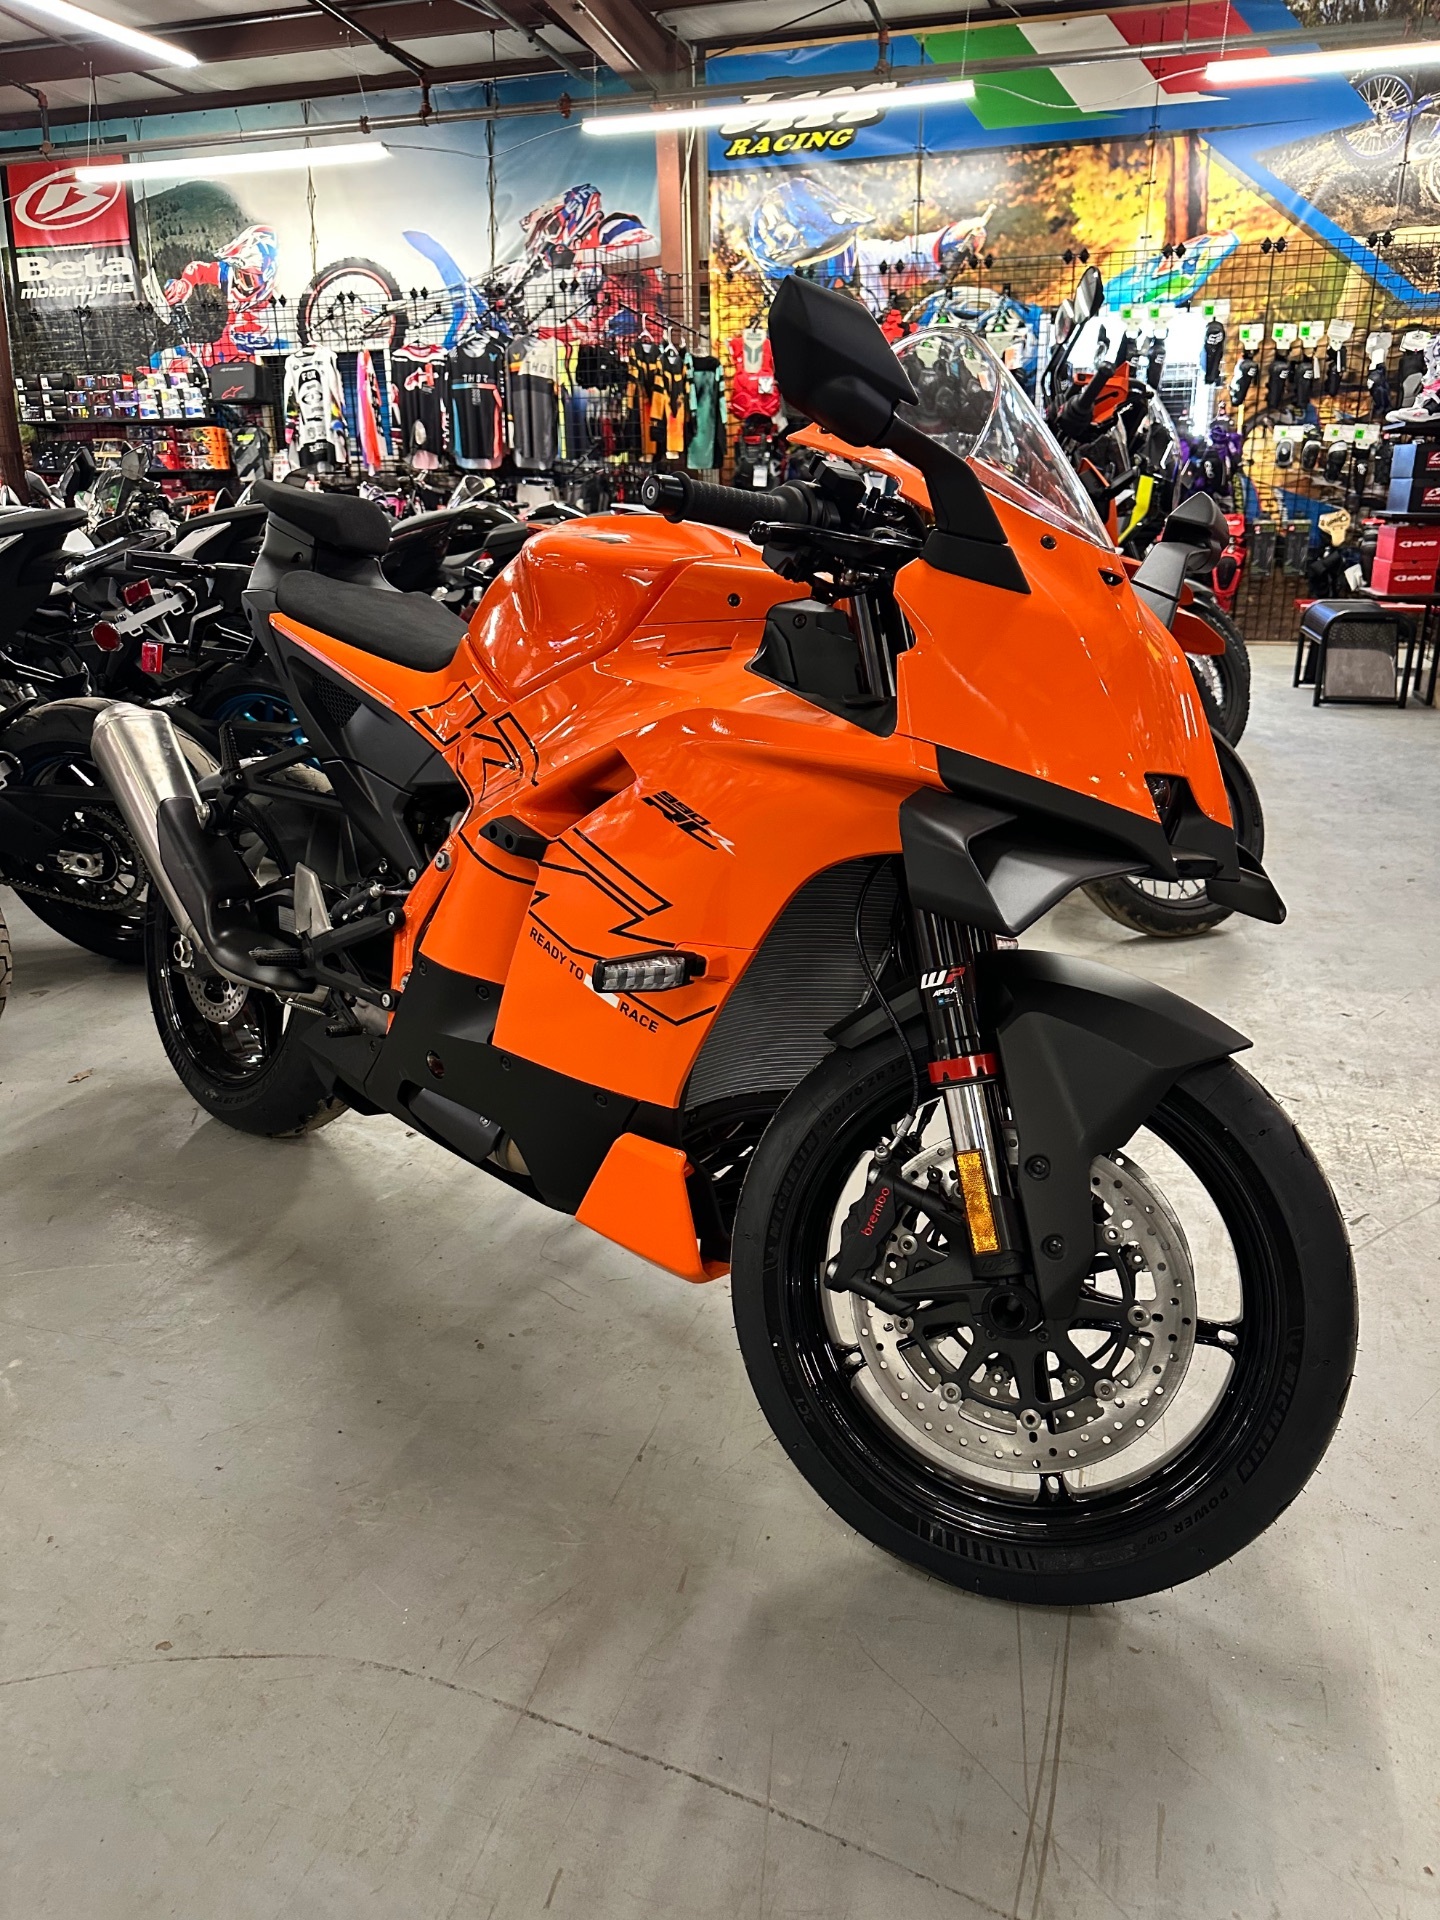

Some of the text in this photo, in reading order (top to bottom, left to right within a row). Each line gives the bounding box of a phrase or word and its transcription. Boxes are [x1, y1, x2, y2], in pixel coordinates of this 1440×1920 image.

[725, 128, 854, 157] RACING
[17, 253, 134, 282] Beta
[21, 280, 135, 299] motorcycles
[529, 926, 659, 1033] READY TO RACE
[921, 966, 966, 990] WP
[932, 986, 957, 998] APEX
[860, 1187, 890, 1237] brembo
[1238, 1360, 1299, 1479] MICHELIN
[1174, 1487, 1229, 1534] POWER
